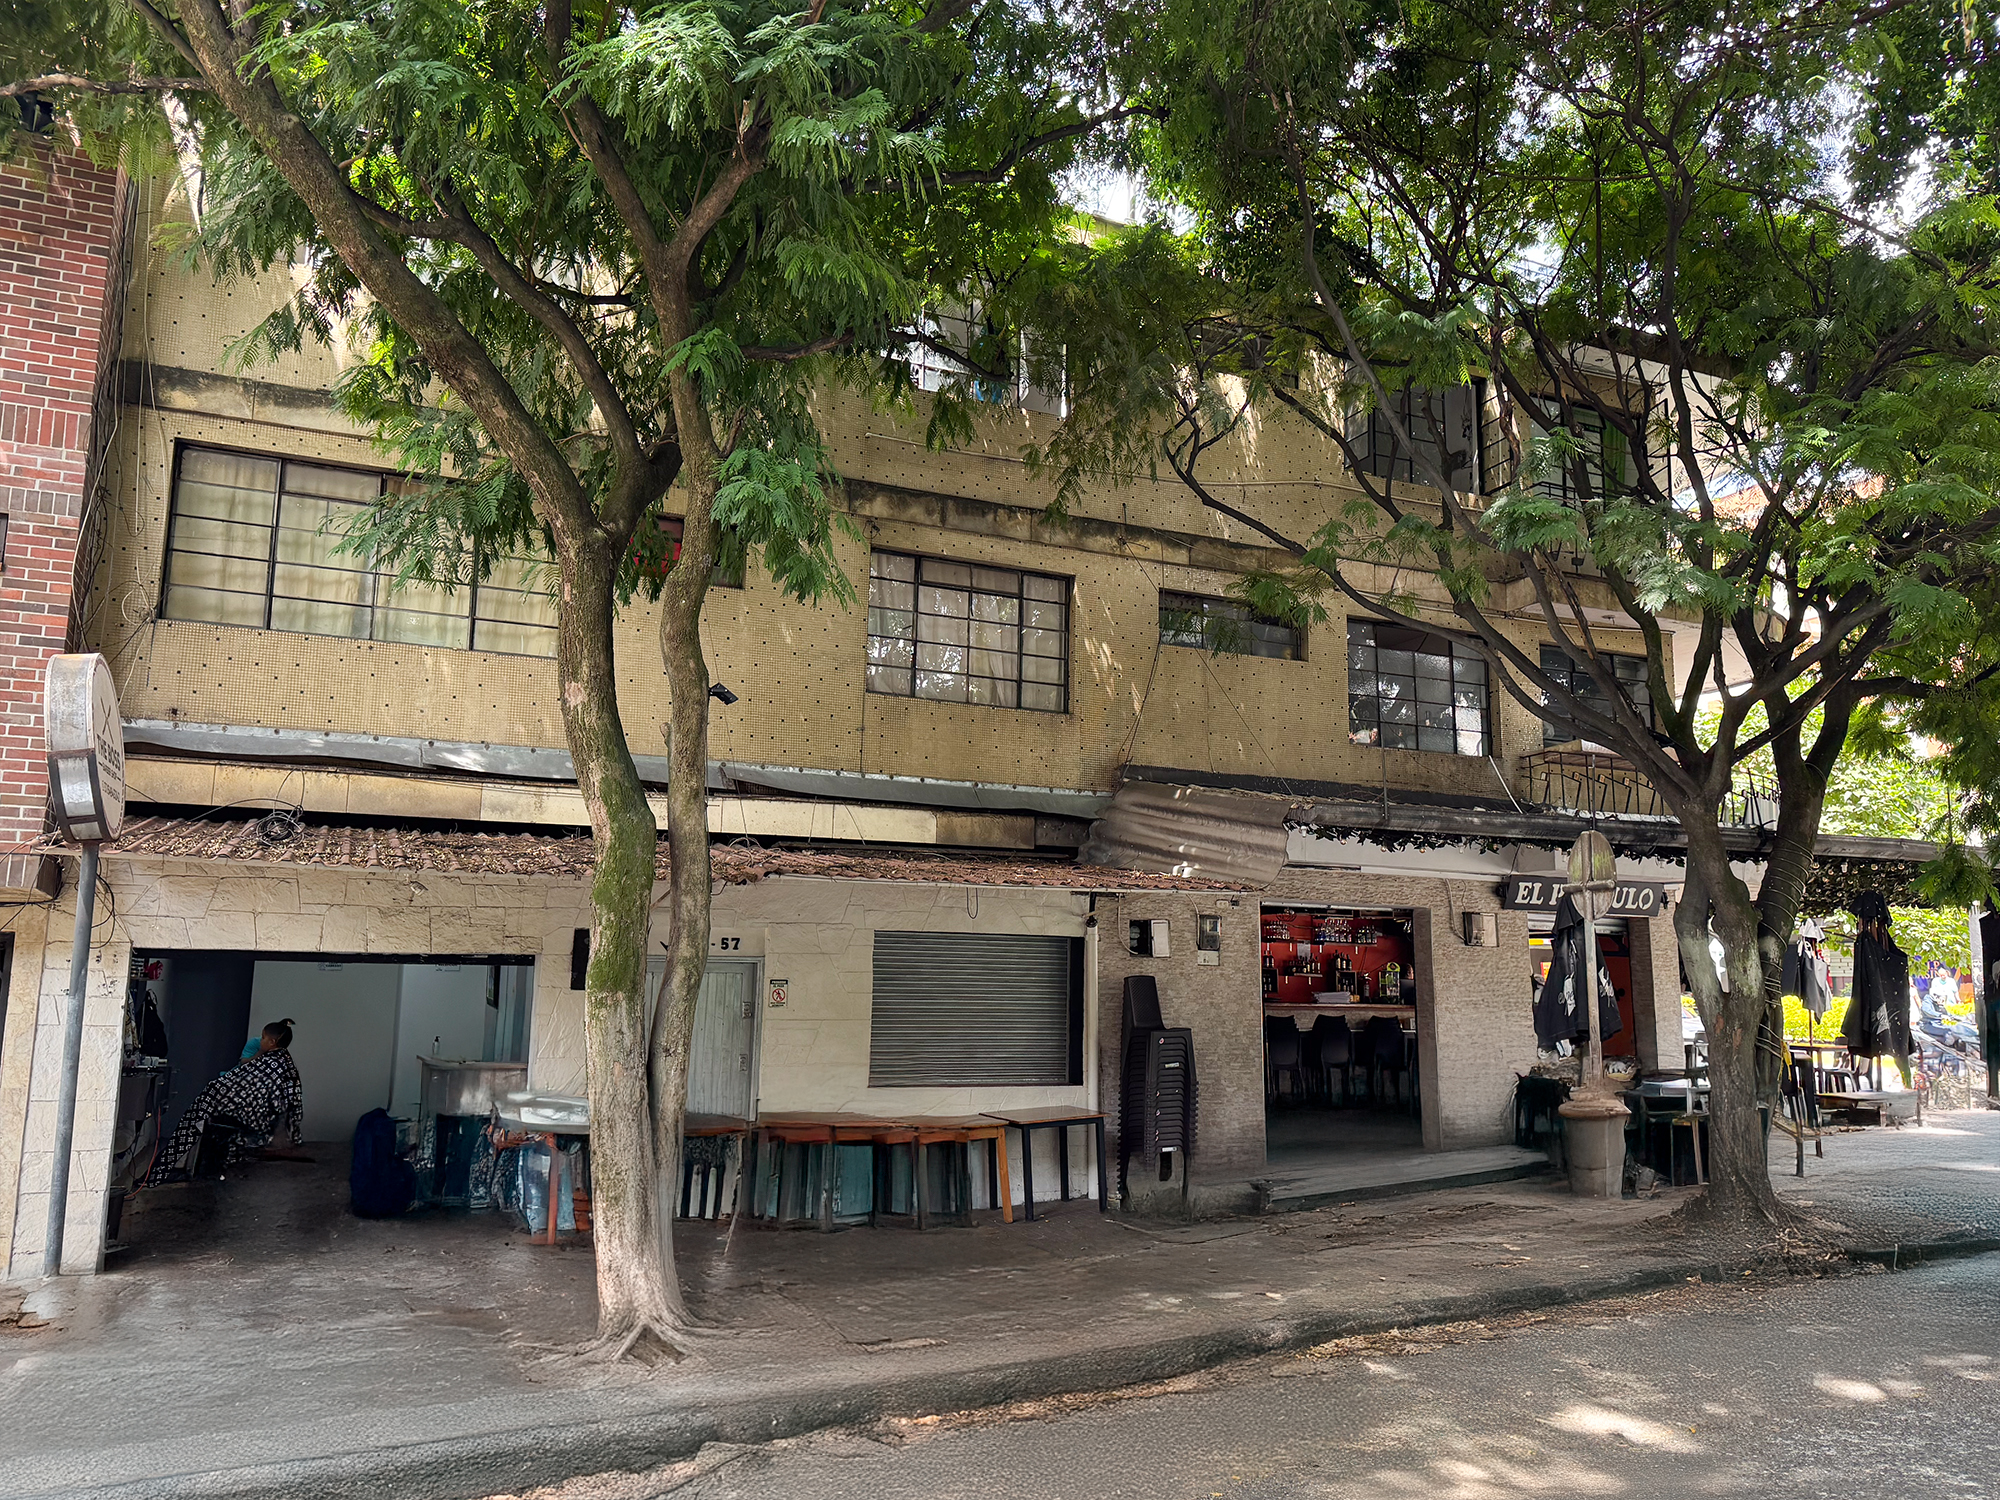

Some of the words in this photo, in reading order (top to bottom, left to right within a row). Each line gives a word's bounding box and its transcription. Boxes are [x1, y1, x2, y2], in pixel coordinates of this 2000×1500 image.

[96, 733, 108, 761] THE
[107, 743, 121, 772] BOSS
[1514, 881, 1544, 905] EL
[720, 937, 741, 950] 57
